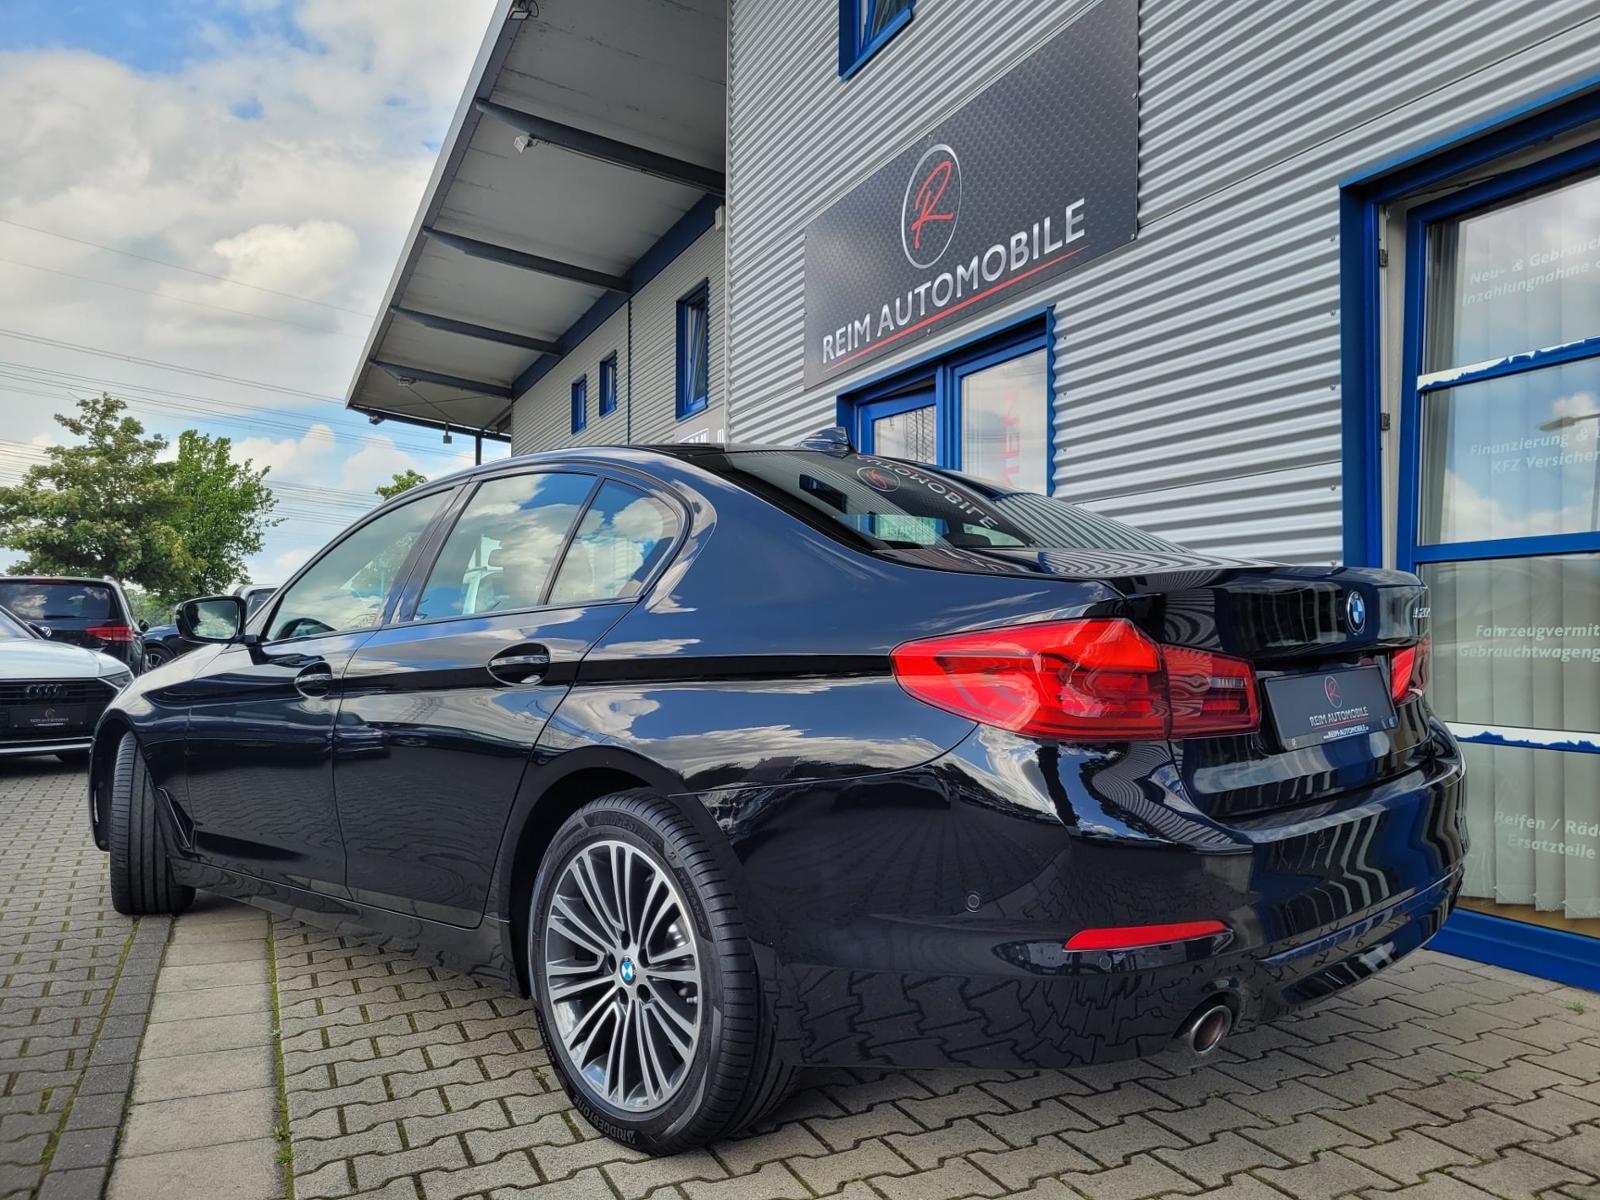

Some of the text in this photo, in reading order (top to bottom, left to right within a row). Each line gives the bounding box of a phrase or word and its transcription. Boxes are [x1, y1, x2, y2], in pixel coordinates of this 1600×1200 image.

[823, 198, 1086, 364] REIM AUTOMOBILE
[1462, 263, 1590, 306] Inzahlungnahme
[1469, 268, 1505, 285] Neu-
[1512, 258, 1524, 272] &
[1470, 433, 1569, 457] Finanzierung
[1576, 427, 1588, 441] &
[1490, 458, 1521, 475] KFZ
[1309, 706, 1369, 727] REIM AUTOMOBILE
[1495, 811, 1545, 832] Reifen
[1508, 834, 1596, 860] Ersatzteile
[573, 1094, 637, 1146] BRIDGESTONE
